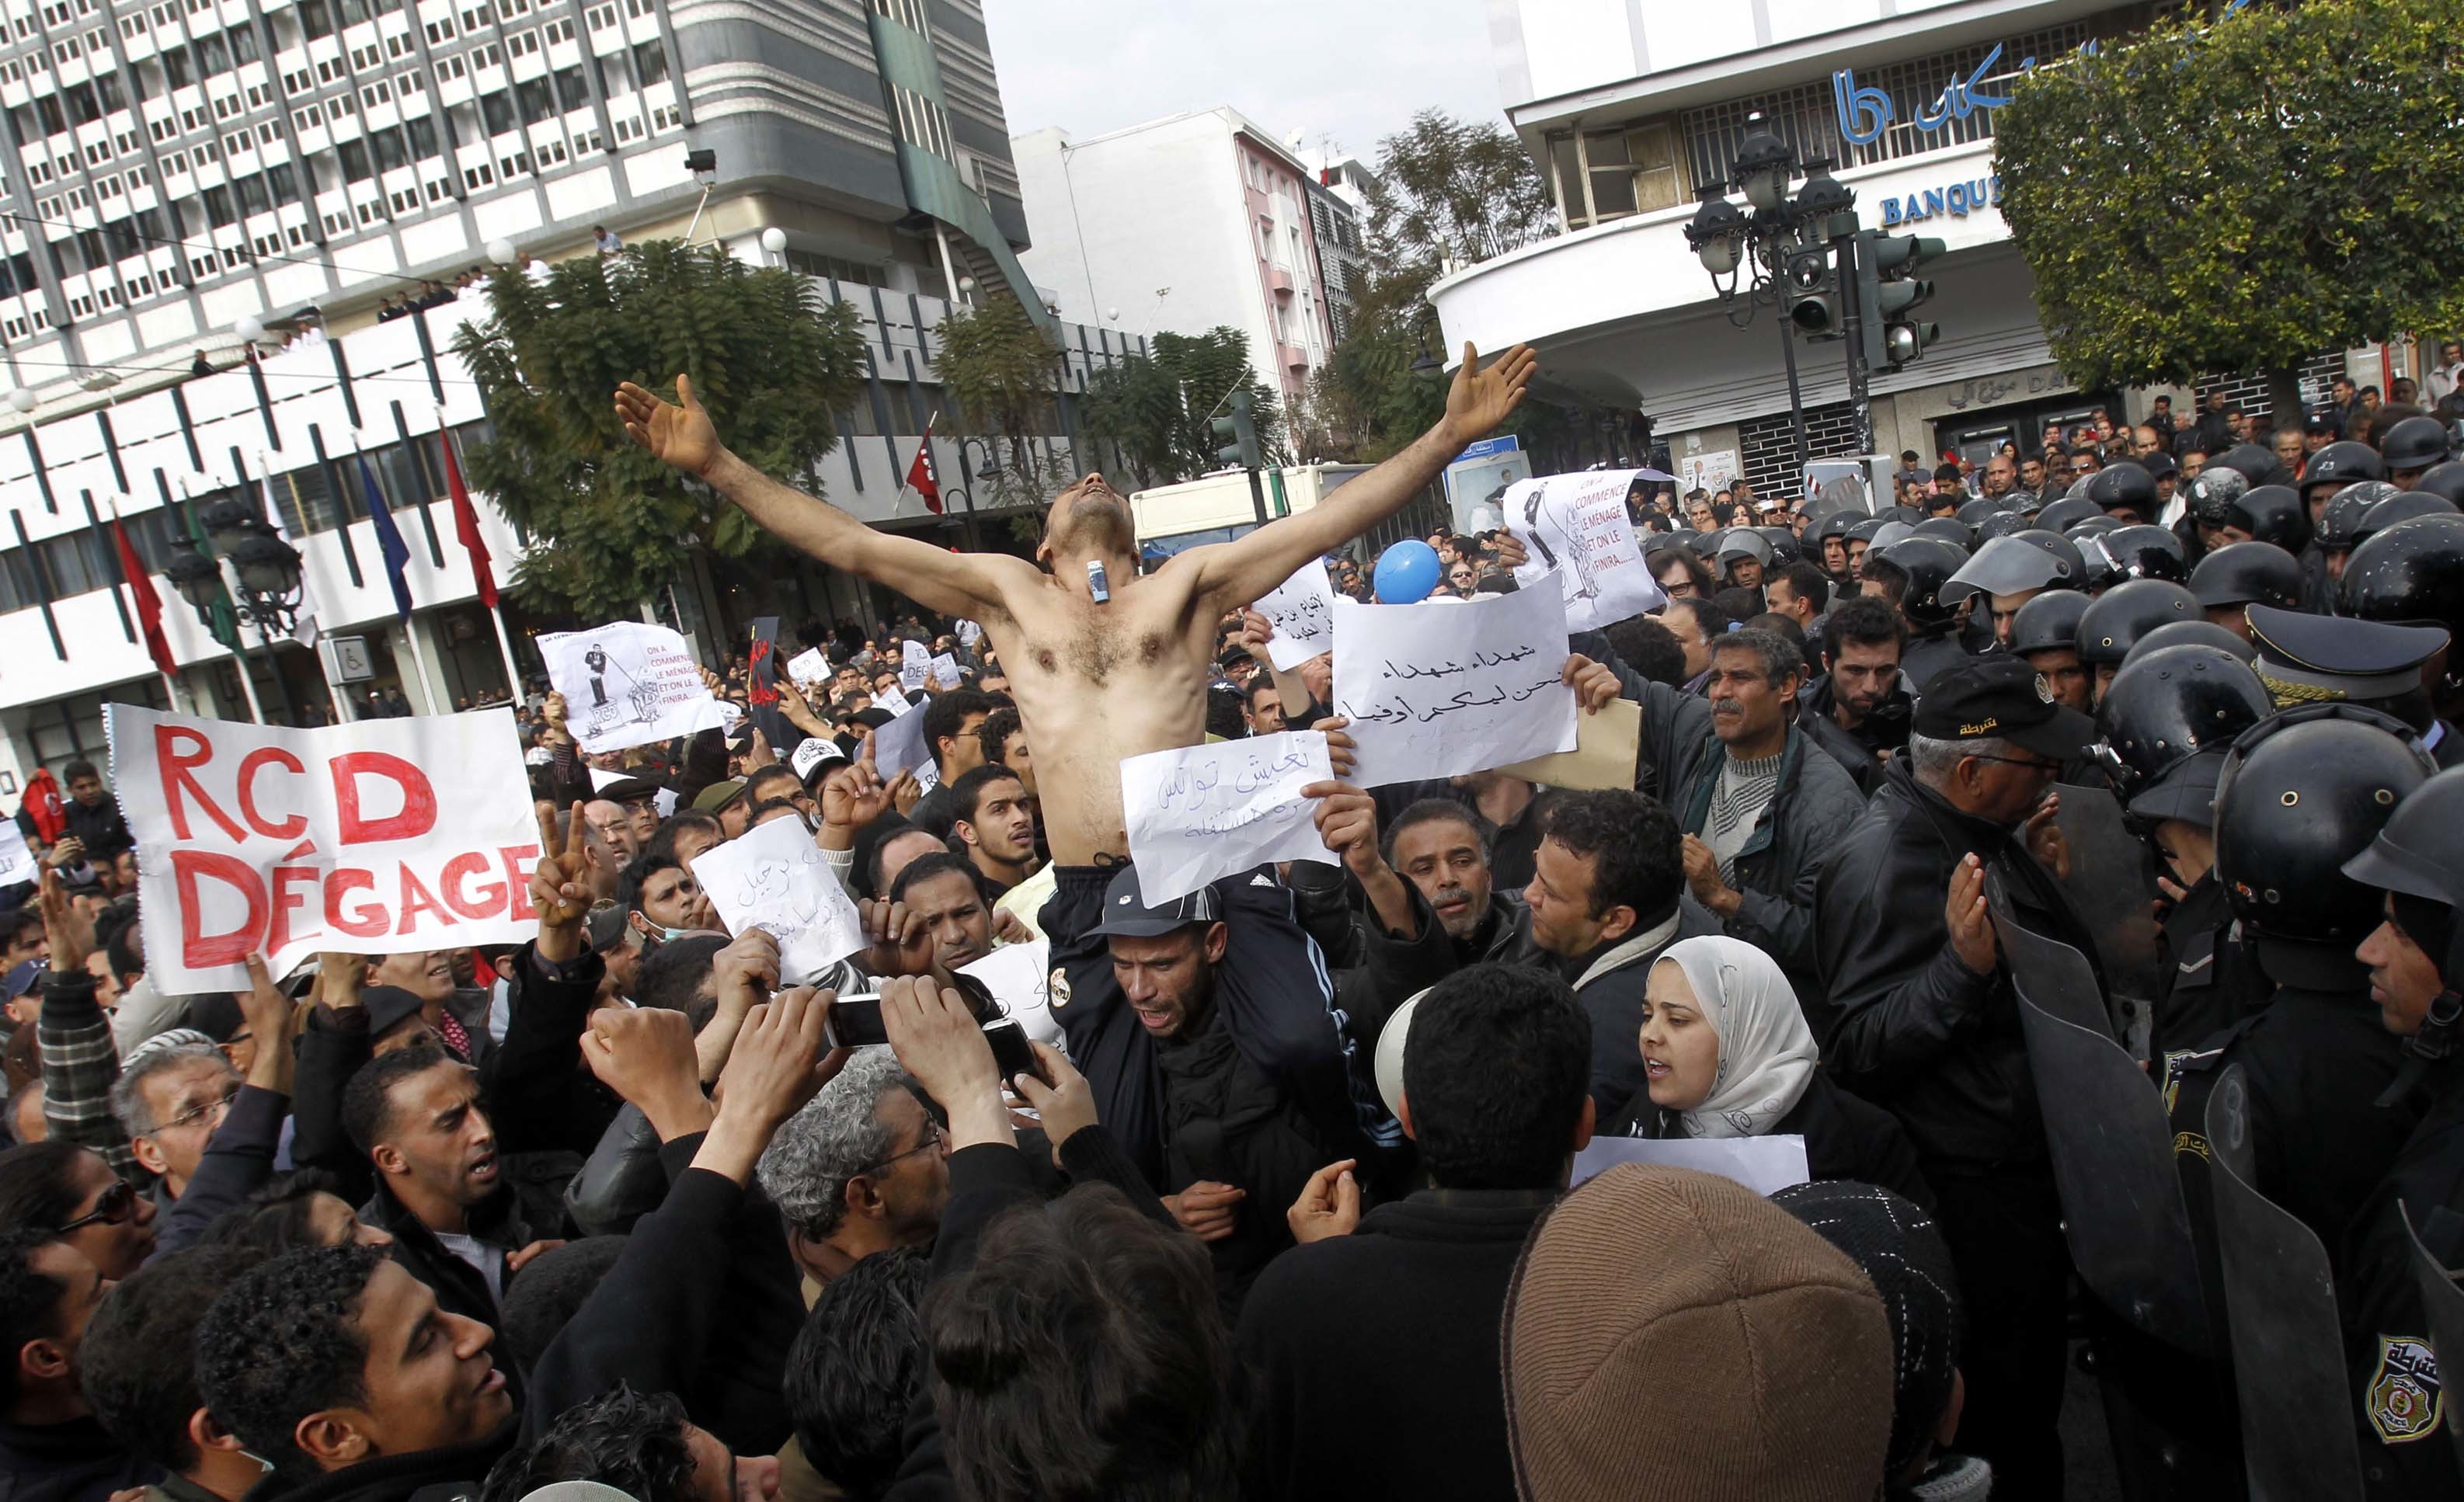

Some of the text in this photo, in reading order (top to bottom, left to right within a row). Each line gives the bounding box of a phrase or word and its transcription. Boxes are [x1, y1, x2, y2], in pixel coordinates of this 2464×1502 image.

[1575, 482, 1627, 510] COMMENCE
[1579, 505, 1622, 531] LE MÉNAGE
[1586, 530, 1621, 552] ET ON LE
[646, 646, 660, 655] ON
[1383, 645, 1536, 680] شهداء شهداء
[656, 671, 665, 680] LE
[659, 679, 694, 694] ET ON LE
[1512, 670, 1562, 701] نحن
[1959, 717, 1997, 735] شرطة
[1236, 737, 1310, 794] تعيش
[155, 724, 437, 846] RCD
[169, 839, 541, 970] DÉGAGE
[2384, 1410, 2407, 1427] POLICE
